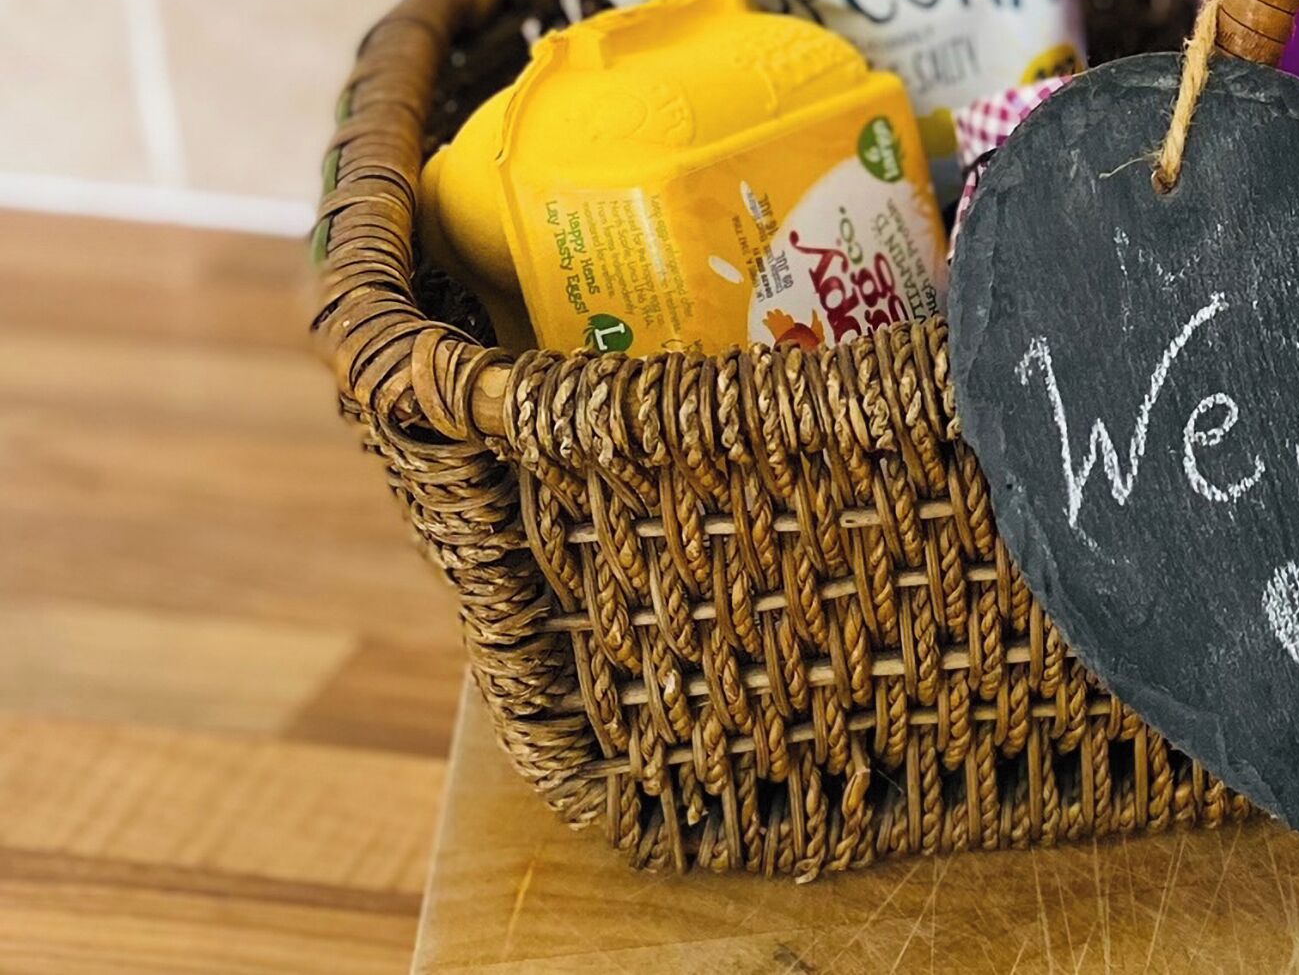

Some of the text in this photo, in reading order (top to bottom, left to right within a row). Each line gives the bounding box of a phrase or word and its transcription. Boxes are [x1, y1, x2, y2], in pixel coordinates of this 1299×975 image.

[567, 211, 586, 254] Happy
[545, 201, 589, 315] Lay Tasty Eggs!
[595, 323, 625, 351] L
